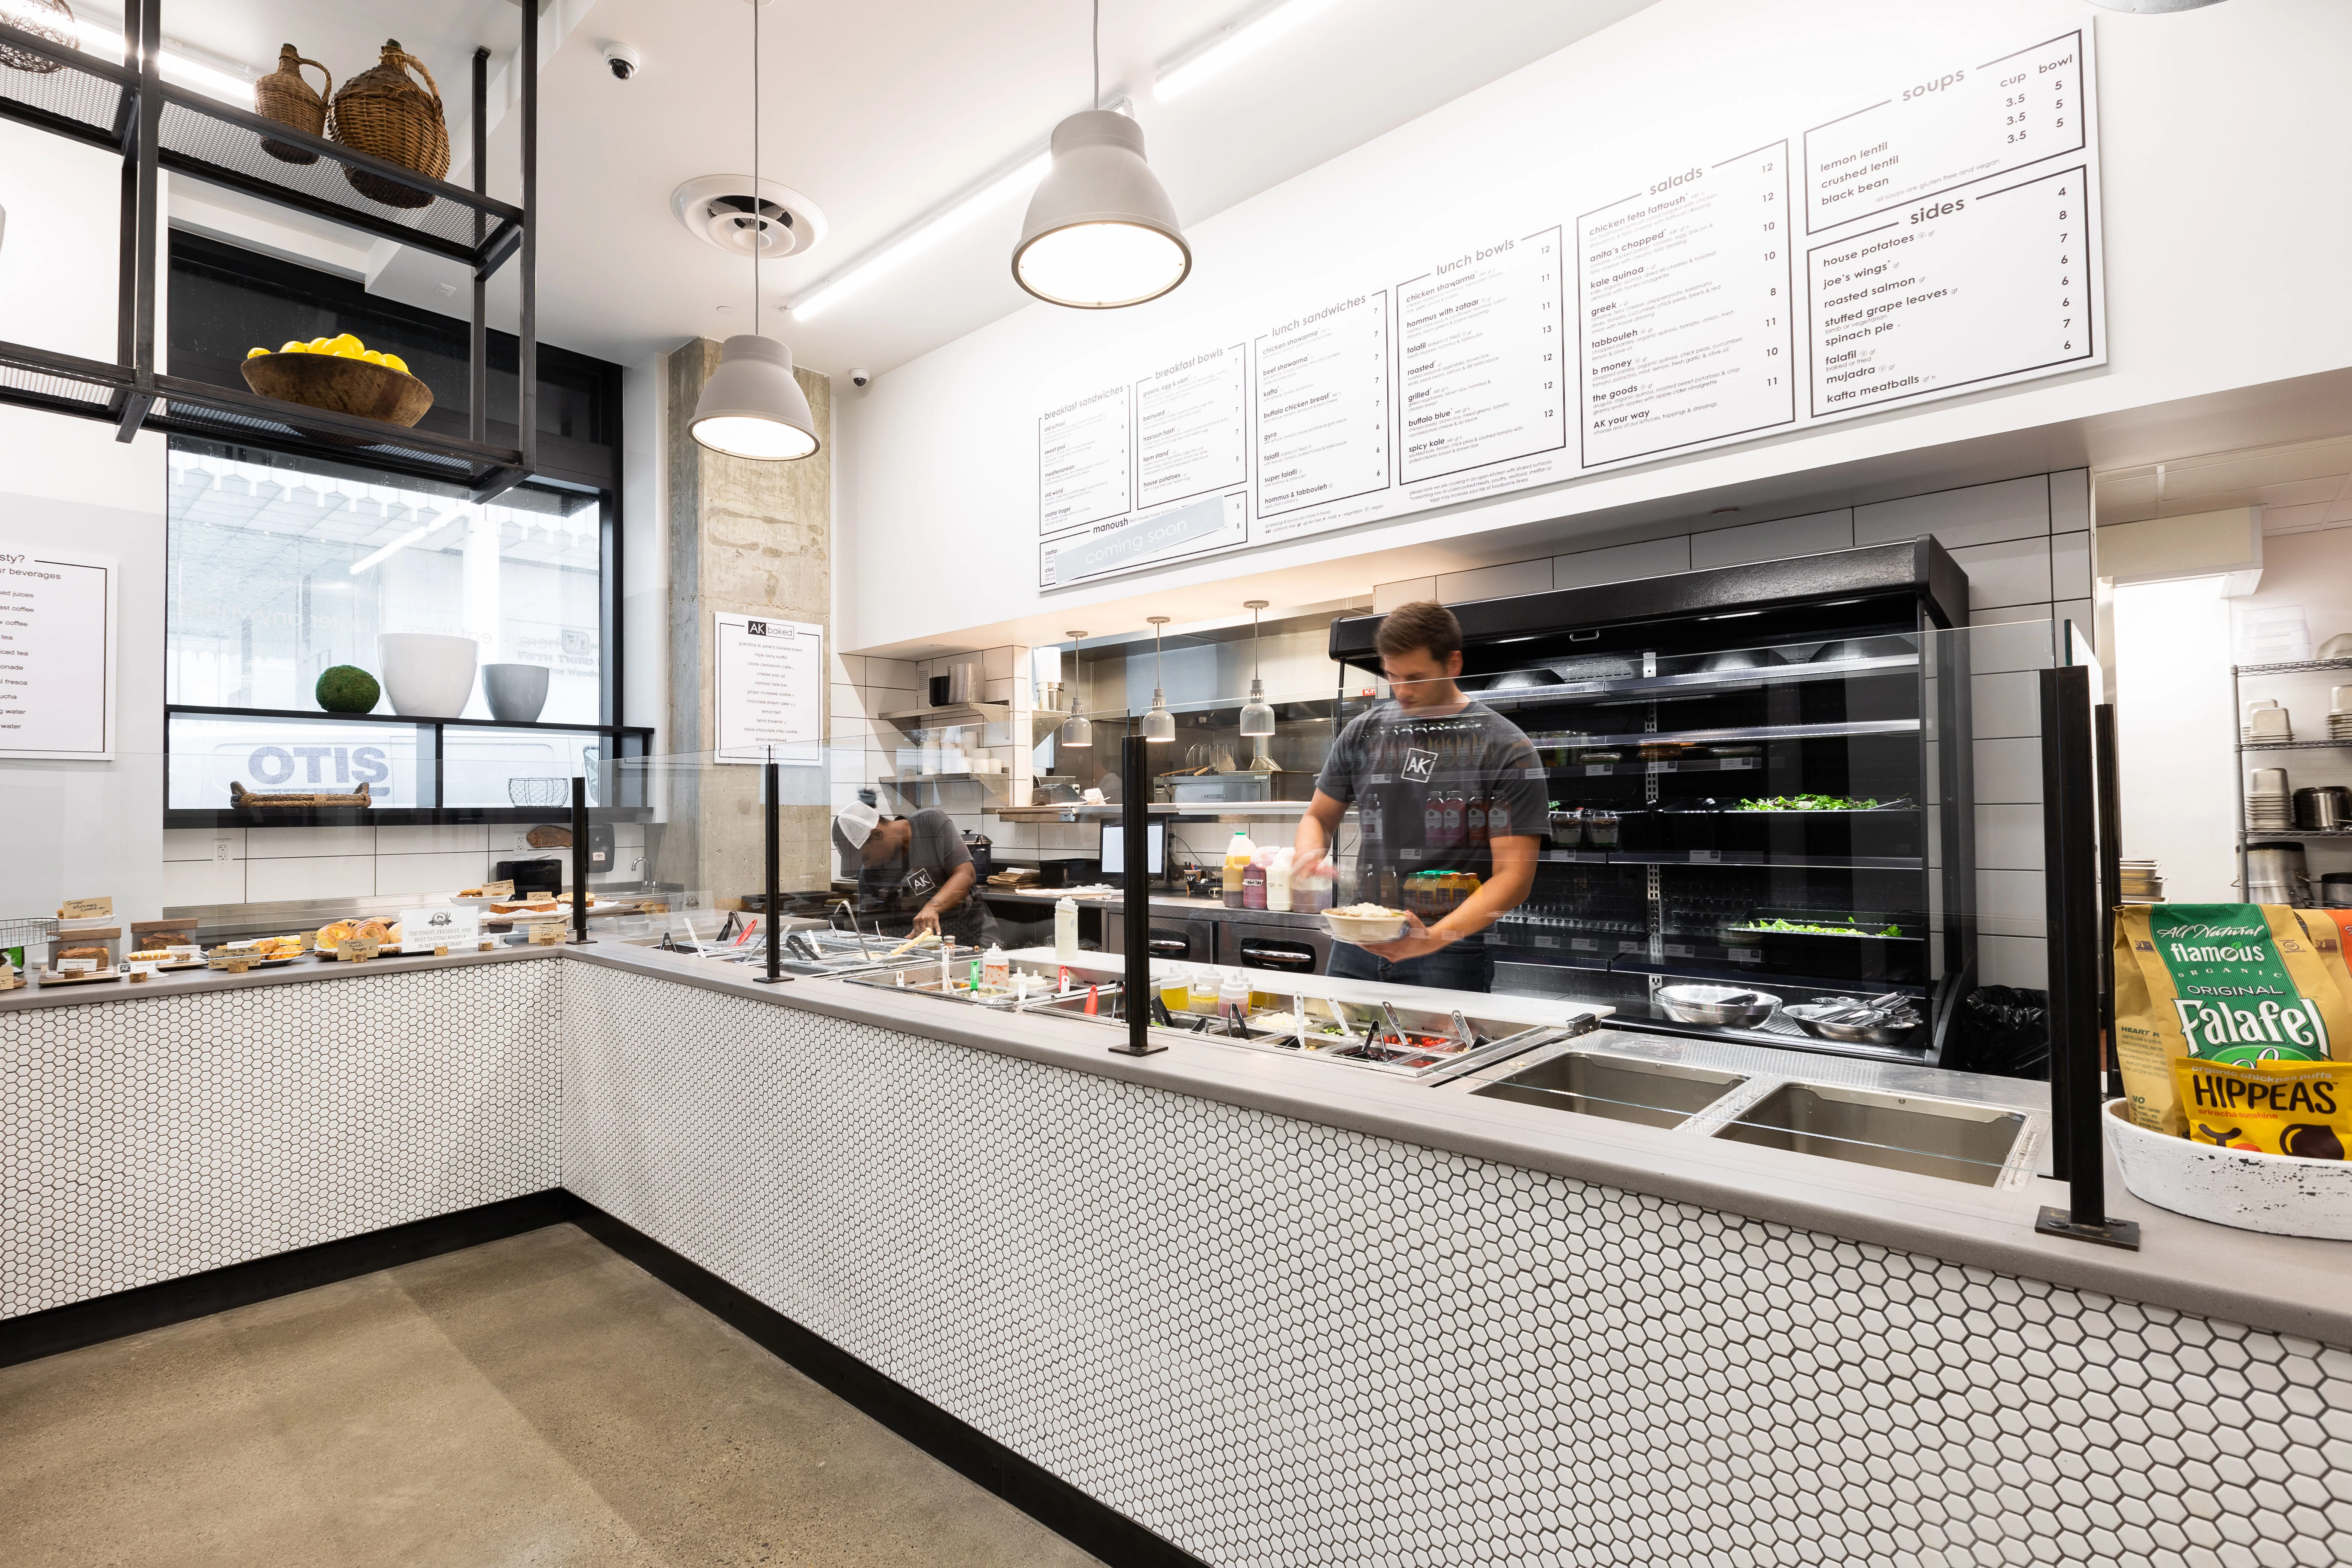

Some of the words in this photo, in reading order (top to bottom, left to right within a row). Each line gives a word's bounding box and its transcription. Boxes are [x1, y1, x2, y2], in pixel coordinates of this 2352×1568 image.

[2039, 54, 2072, 74] bowl
[1903, 70, 1964, 101] soups
[2000, 73, 2026, 87] cup
[2055, 80, 2062, 90] 5
[2006, 93, 2025, 107] 3.5
[2055, 99, 2062, 109] 5
[2007, 111, 2025, 125] 3.5
[2056, 117, 2063, 128] 5
[2008, 130, 2026, 144] 3.5
[1821, 155, 1856, 172] lemon
[1860, 141, 1887, 158] lentil
[1762, 163, 1773, 173] 12
[1821, 166, 1867, 188] crushed
[1871, 155, 1898, 172] lentil
[1650, 168, 1703, 195] salads
[1885, 190, 1904, 200] soups
[1919, 178, 1942, 190] gluten
[1959, 166, 1974, 175] and
[1976, 159, 2000, 169] vegan
[1763, 192, 1774, 202] 12
[1822, 189, 1854, 205] black
[1858, 178, 1889, 193] bean
[1911, 199, 1964, 224] sides
[1763, 222, 1774, 232] 10
[1437, 255, 1471, 276] lunch
[1476, 239, 1514, 261] bowls
[1823, 252, 1858, 267] house
[1862, 235, 1914, 258] potatoes
[1591, 278, 1610, 289] kale
[1613, 267, 1644, 282] quinoa
[1770, 288, 1776, 296] 8
[1825, 288, 1868, 308] roasted
[1872, 278, 1915, 295] salmon
[1273, 319, 1299, 337] lunch
[1303, 295, 1366, 325] sandwiches
[1407, 314, 1437, 328] hommus
[1439, 307, 1453, 317] with
[1455, 299, 1479, 312] zataar
[1591, 302, 1617, 317] greek
[1825, 309, 1862, 327] stuffed
[1866, 301, 1902, 318] grape
[1907, 289, 1947, 305] leaves
[1766, 318, 1776, 327] 11
[1592, 329, 1637, 348] tabbouleh
[1826, 328, 1871, 347] spinach
[1875, 323, 1893, 335] pie
[1407, 342, 1426, 353] falafil
[1156, 357, 1195, 379] breakfast
[1198, 348, 1223, 364] bowls
[1601, 359, 1632, 373] money
[1825, 350, 1856, 365] falafil
[1827, 367, 1875, 384] mujadra
[1610, 385, 1637, 399] goods
[1827, 391, 1856, 403] kafta
[1860, 376, 1919, 396] meatballs
[1045, 401, 1077, 420] breakfast
[1079, 386, 1123, 407] sandwiches
[1663, 410, 1686, 419] toppings
[1693, 402, 1717, 411] dressings
[1593, 419, 1605, 429] AK
[1608, 415, 1628, 427] your
[1630, 410, 1650, 419] way
[1264, 432, 1277, 441] gyro
[1409, 443, 1427, 453] spicy
[1430, 438, 1445, 447] kale
[1264, 451, 1279, 461] falafil
[1159, 474, 1180, 484] potatoes
[1265, 474, 1280, 483] super
[1281, 469, 1297, 478] falafil
[1265, 494, 1289, 504] hommus
[1296, 483, 1327, 496] tabbouleh
[1093, 517, 1128, 534] manoush
[1085, 536, 1143, 564] coming
[1147, 519, 1187, 542] soon
[9, 568, 61, 580] beverages
[750, 623, 765, 634] AK
[248, 746, 388, 785] OTIS
[1406, 757, 1431, 775] AK
[915, 874, 930, 890] AK
[2157, 925, 2190, 938] All
[2193, 924, 2264, 939] Natural
[2170, 943, 2264, 962] flamous
[2178, 968, 2282, 978] ORGANIC
[2187, 984, 2285, 996] ORIGINAL
[2121, 1026, 2150, 1035] HEART
[2172, 998, 2330, 1056] Falafel
[2192, 1065, 2238, 1076] organic
[2241, 1072, 2297, 1084] chickpea
[2193, 1074, 2337, 1114] HIPPEAS
[2198, 1108, 2237, 1118] sriracha
[2239, 1110, 2278, 1119] sunshine
